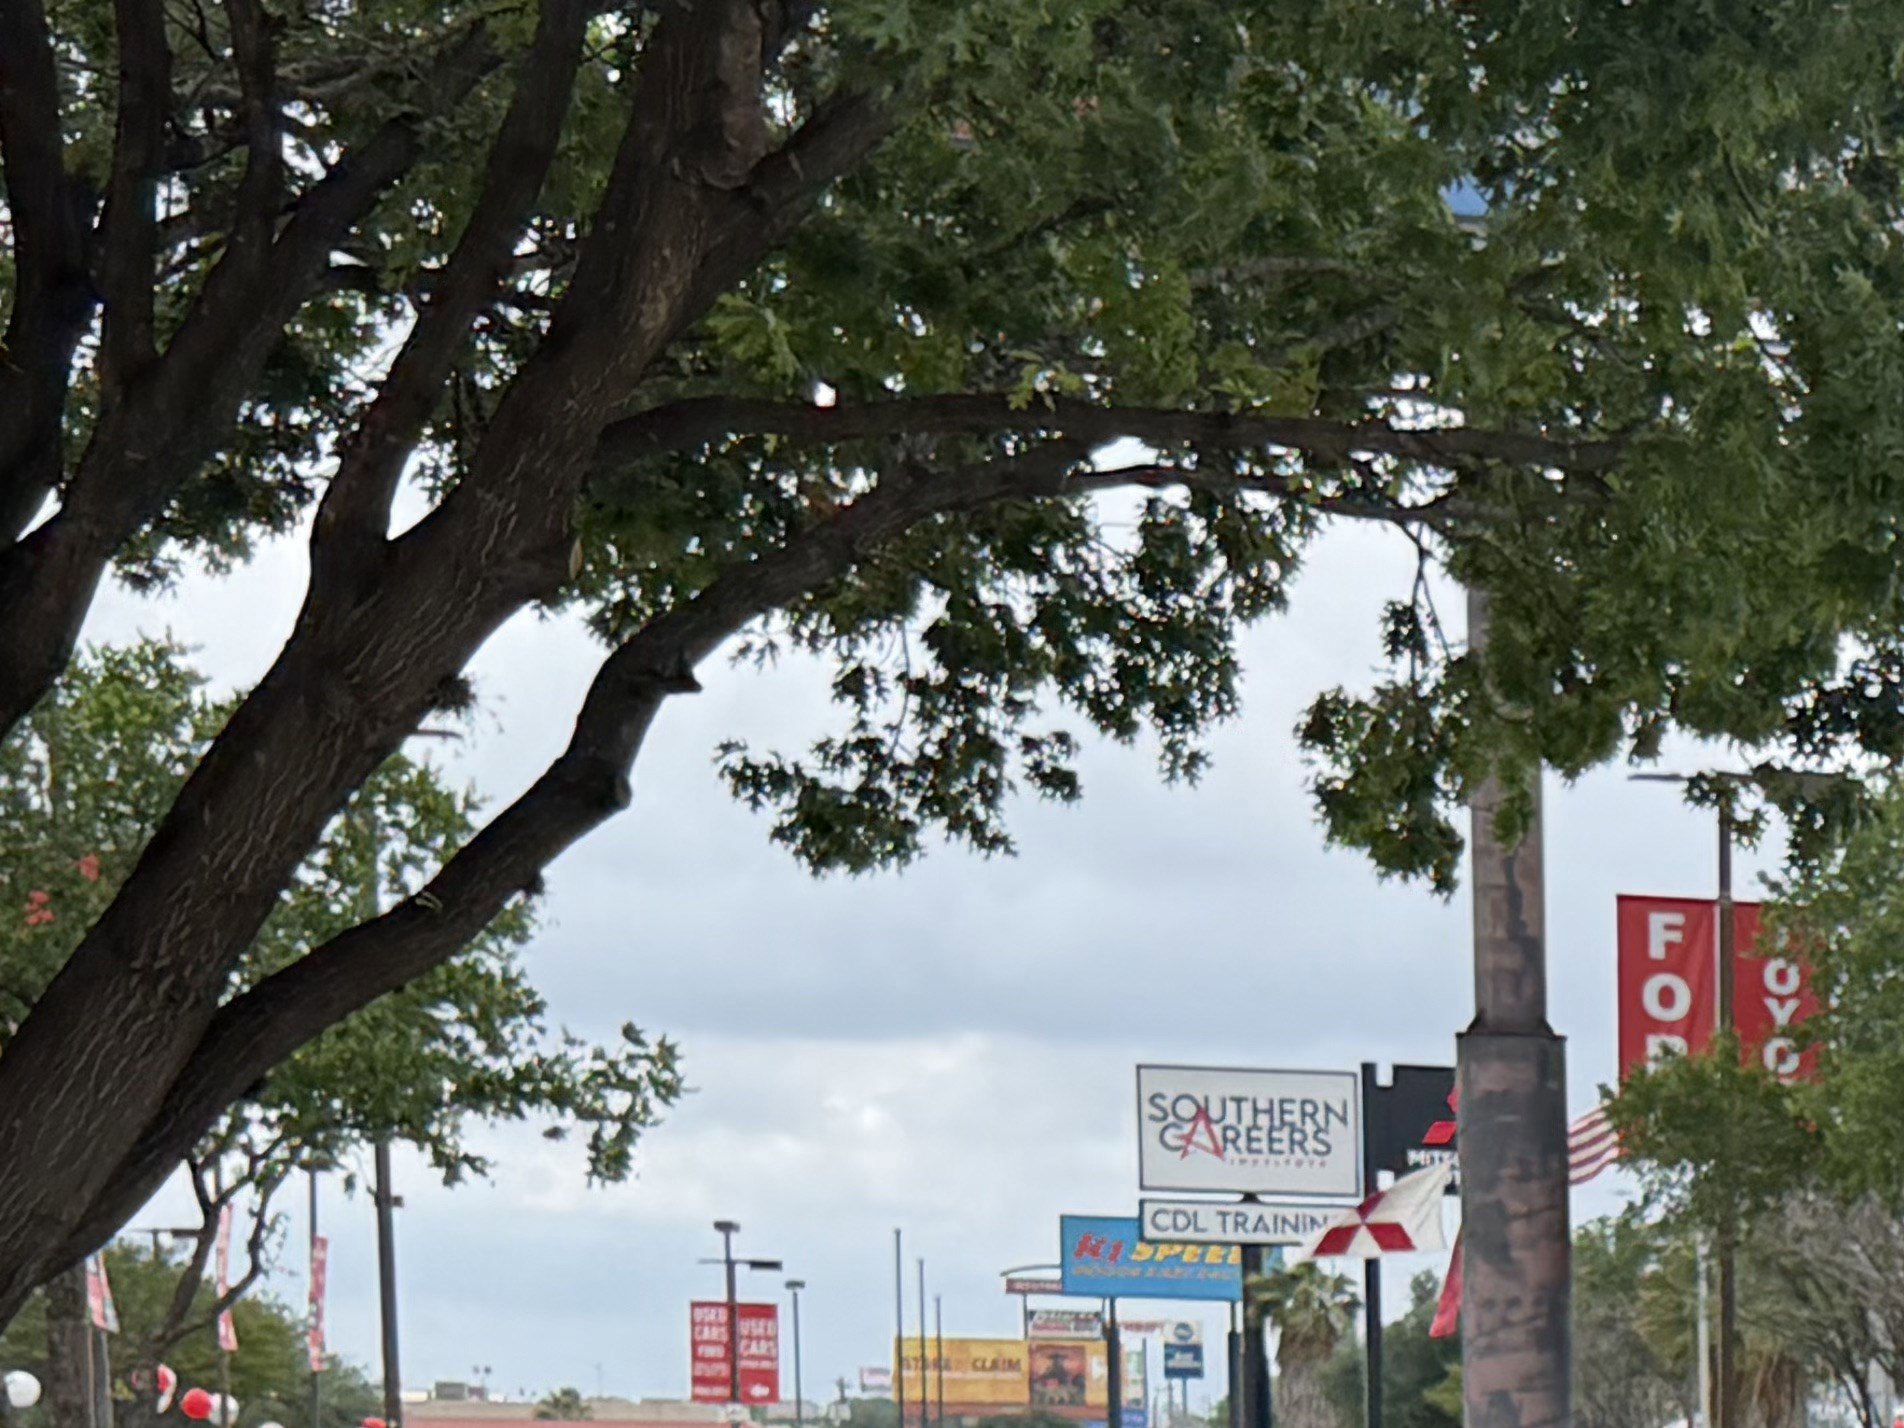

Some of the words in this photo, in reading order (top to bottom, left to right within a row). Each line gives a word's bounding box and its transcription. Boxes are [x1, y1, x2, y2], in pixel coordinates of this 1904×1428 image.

[1147, 1092, 1348, 1131] SOUTHERN
[1159, 1107, 1333, 1161] CAREERS
[1151, 1208, 1208, 1233] CDL
[1216, 1209, 1329, 1237] TRAININ
[740, 1319, 777, 1337] USED
[740, 1339, 777, 1357] CARS
